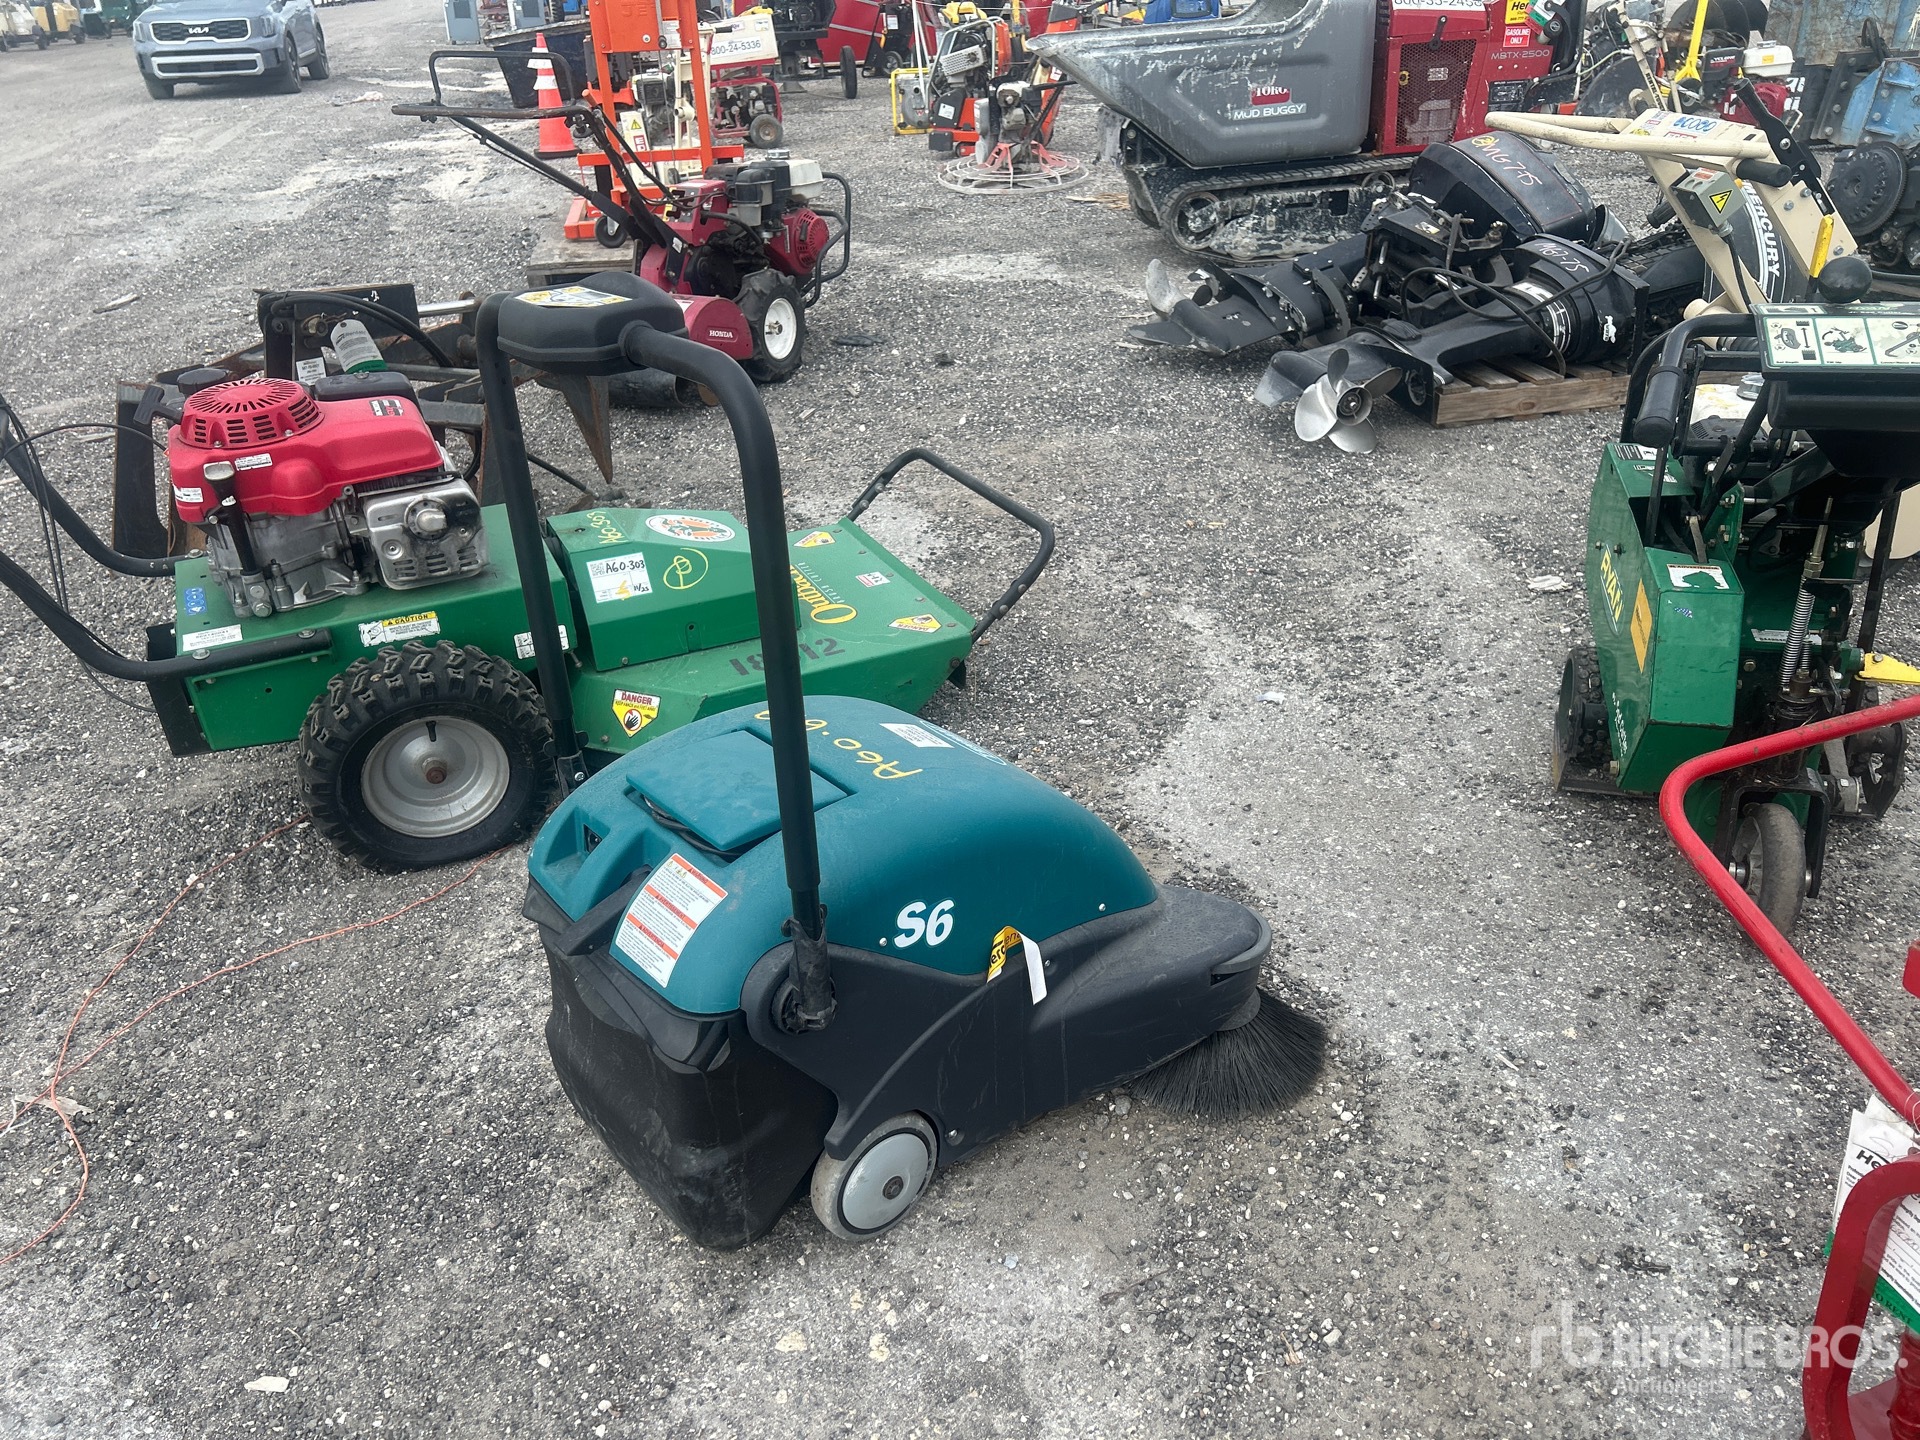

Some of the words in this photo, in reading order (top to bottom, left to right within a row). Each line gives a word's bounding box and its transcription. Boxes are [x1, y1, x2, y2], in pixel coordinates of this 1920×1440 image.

[1506, 27, 1530, 36] GASOLINE
[1233, 109, 1260, 120] MUD
[1263, 105, 1304, 117] BUGGY
[1741, 179, 1781, 278] MERCURY
[708, 329, 734, 339] HONDA
[605, 559, 645, 574] A60-303
[1600, 549, 1625, 623] RYAN
[395, 613, 429, 625] CAUTION
[620, 691, 653, 706] DANGER
[893, 899, 955, 948] S6
